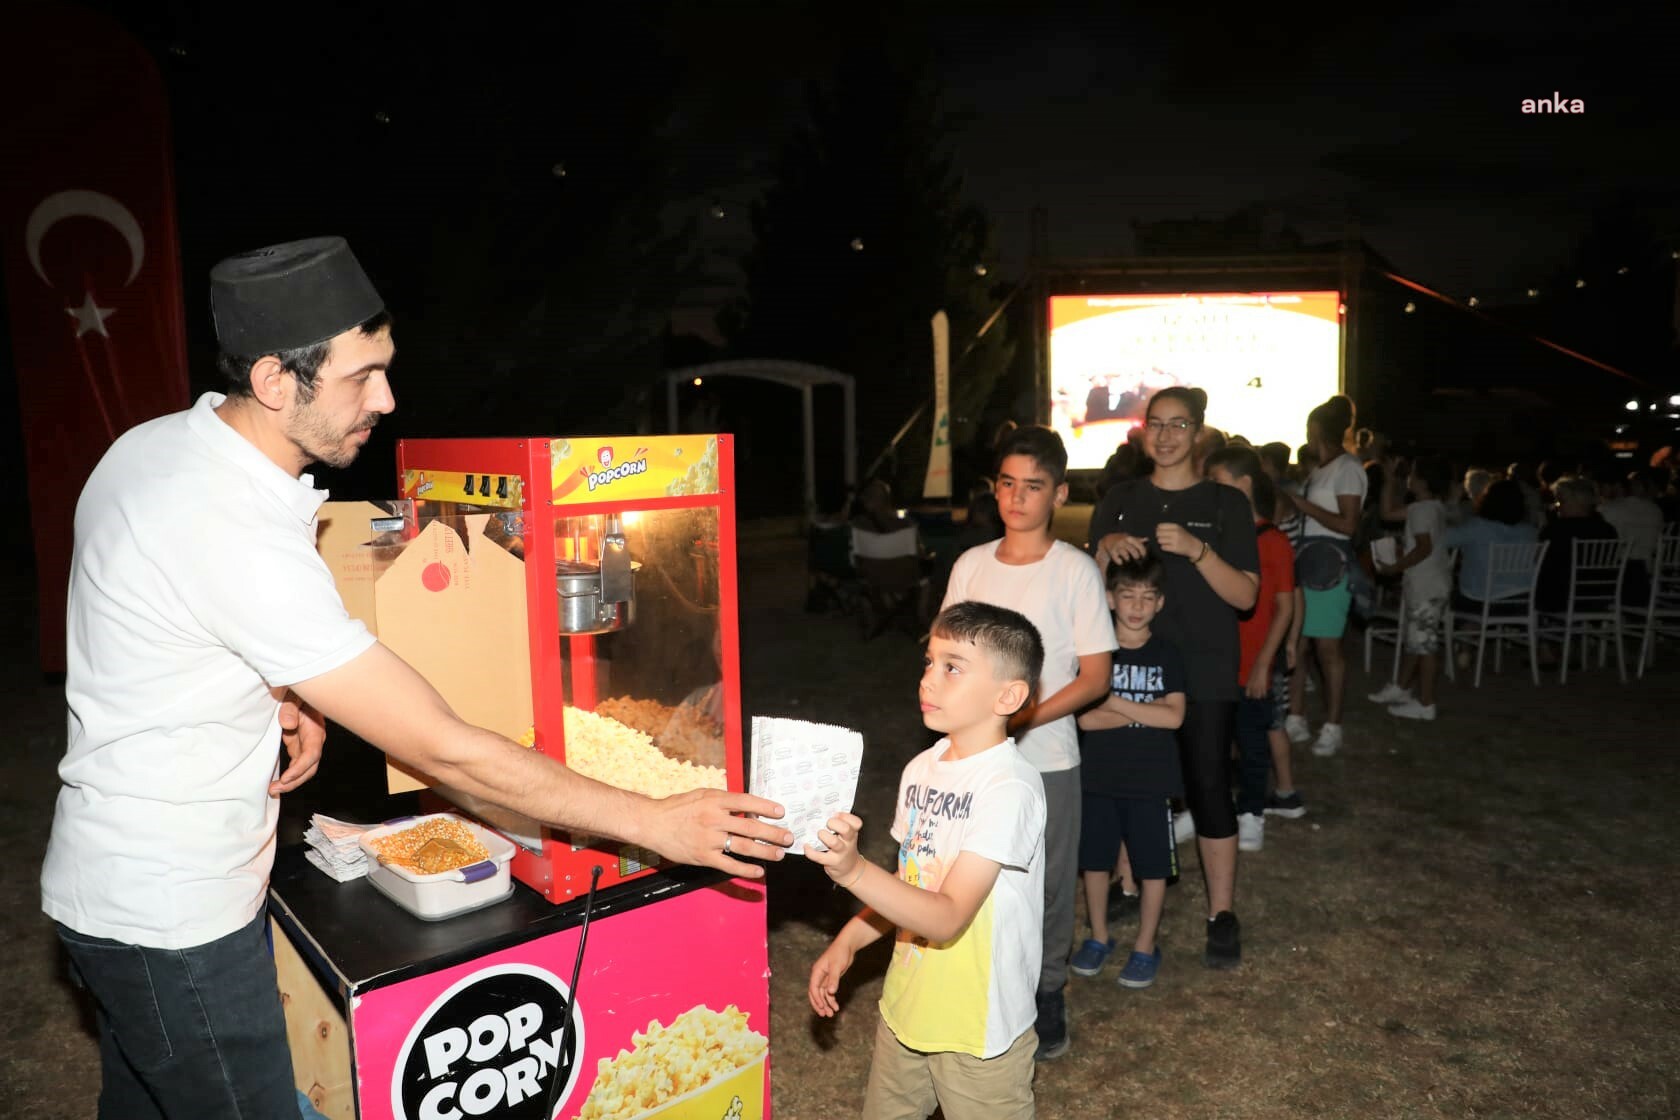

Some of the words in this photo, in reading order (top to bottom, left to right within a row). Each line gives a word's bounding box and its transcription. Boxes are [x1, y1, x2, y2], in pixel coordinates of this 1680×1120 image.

[588, 458, 647, 491] POPCORN
[418, 1026, 570, 1120] CORN
[423, 1002, 544, 1080] POP
